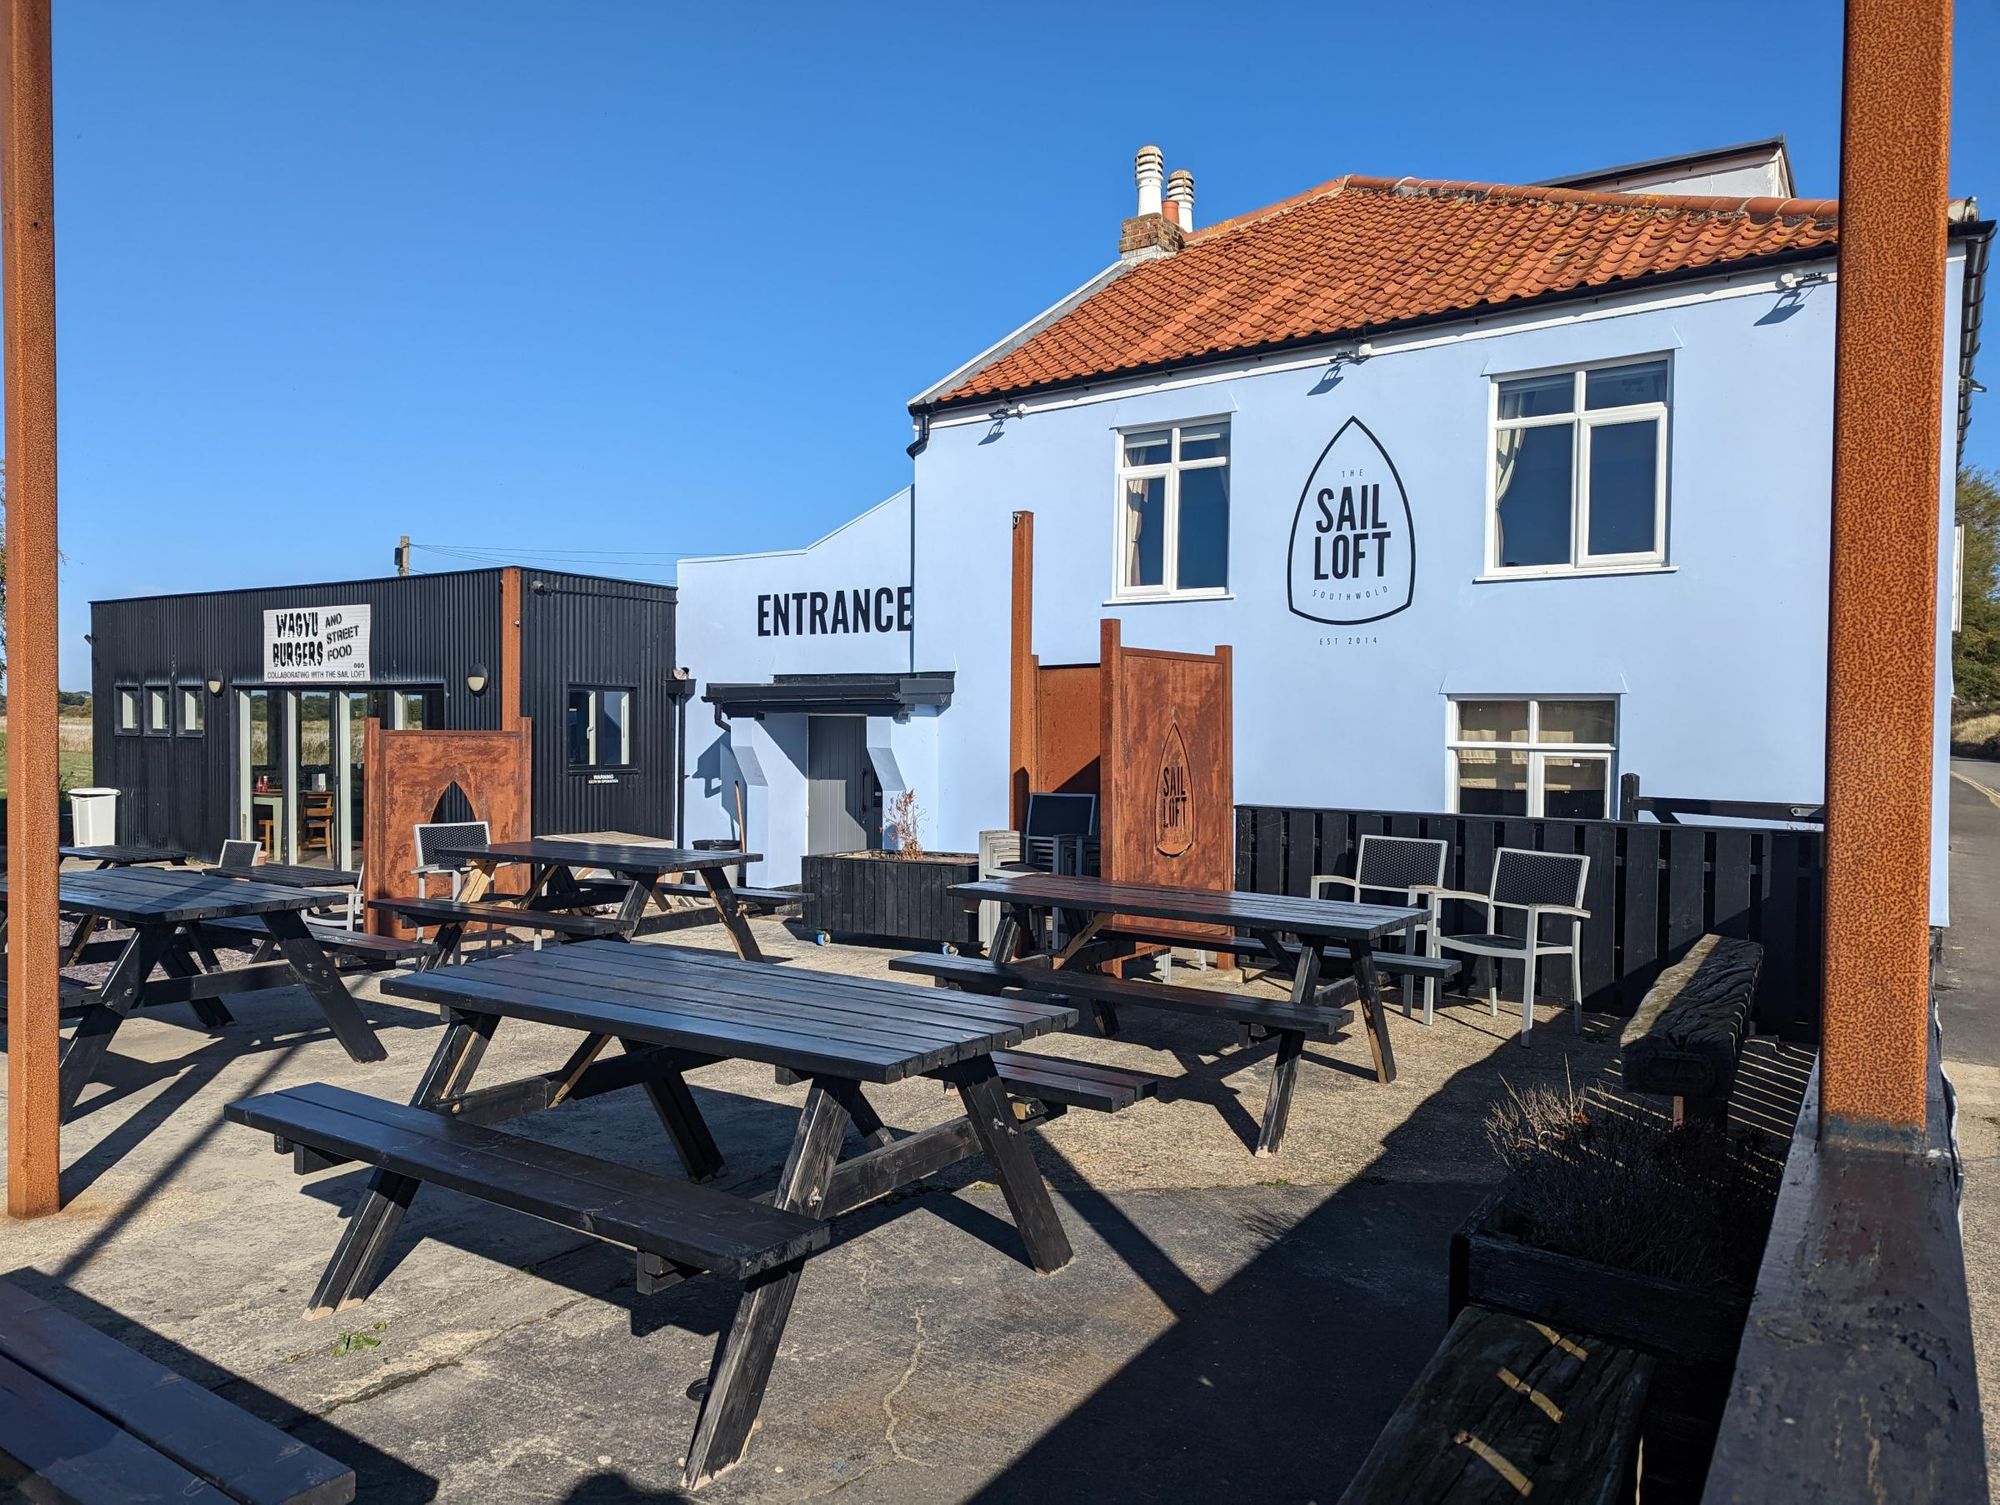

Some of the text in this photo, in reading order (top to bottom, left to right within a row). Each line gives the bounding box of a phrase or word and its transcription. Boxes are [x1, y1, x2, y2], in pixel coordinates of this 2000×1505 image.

[1342, 468, 1364, 478] THE
[1315, 483, 1388, 534] SAIL
[1313, 531, 1392, 581] LOFT
[1312, 585, 1388, 600] SOUTHWOLD
[325, 613, 342, 628] AND
[757, 586, 913, 637] ENTRANCE
[276, 612, 318, 638] WAGYU
[326, 625, 360, 645] STREET
[327, 644, 353, 661] FOOD
[1319, 636, 1378, 646] EST 2014
[272, 641, 323, 668] BURGERS
[267, 670, 366, 679] COLLABORATING WITH THE SAIL LOFT
[1163, 766, 1186, 797] SAIL
[1162, 796, 1187, 829] LOFT
